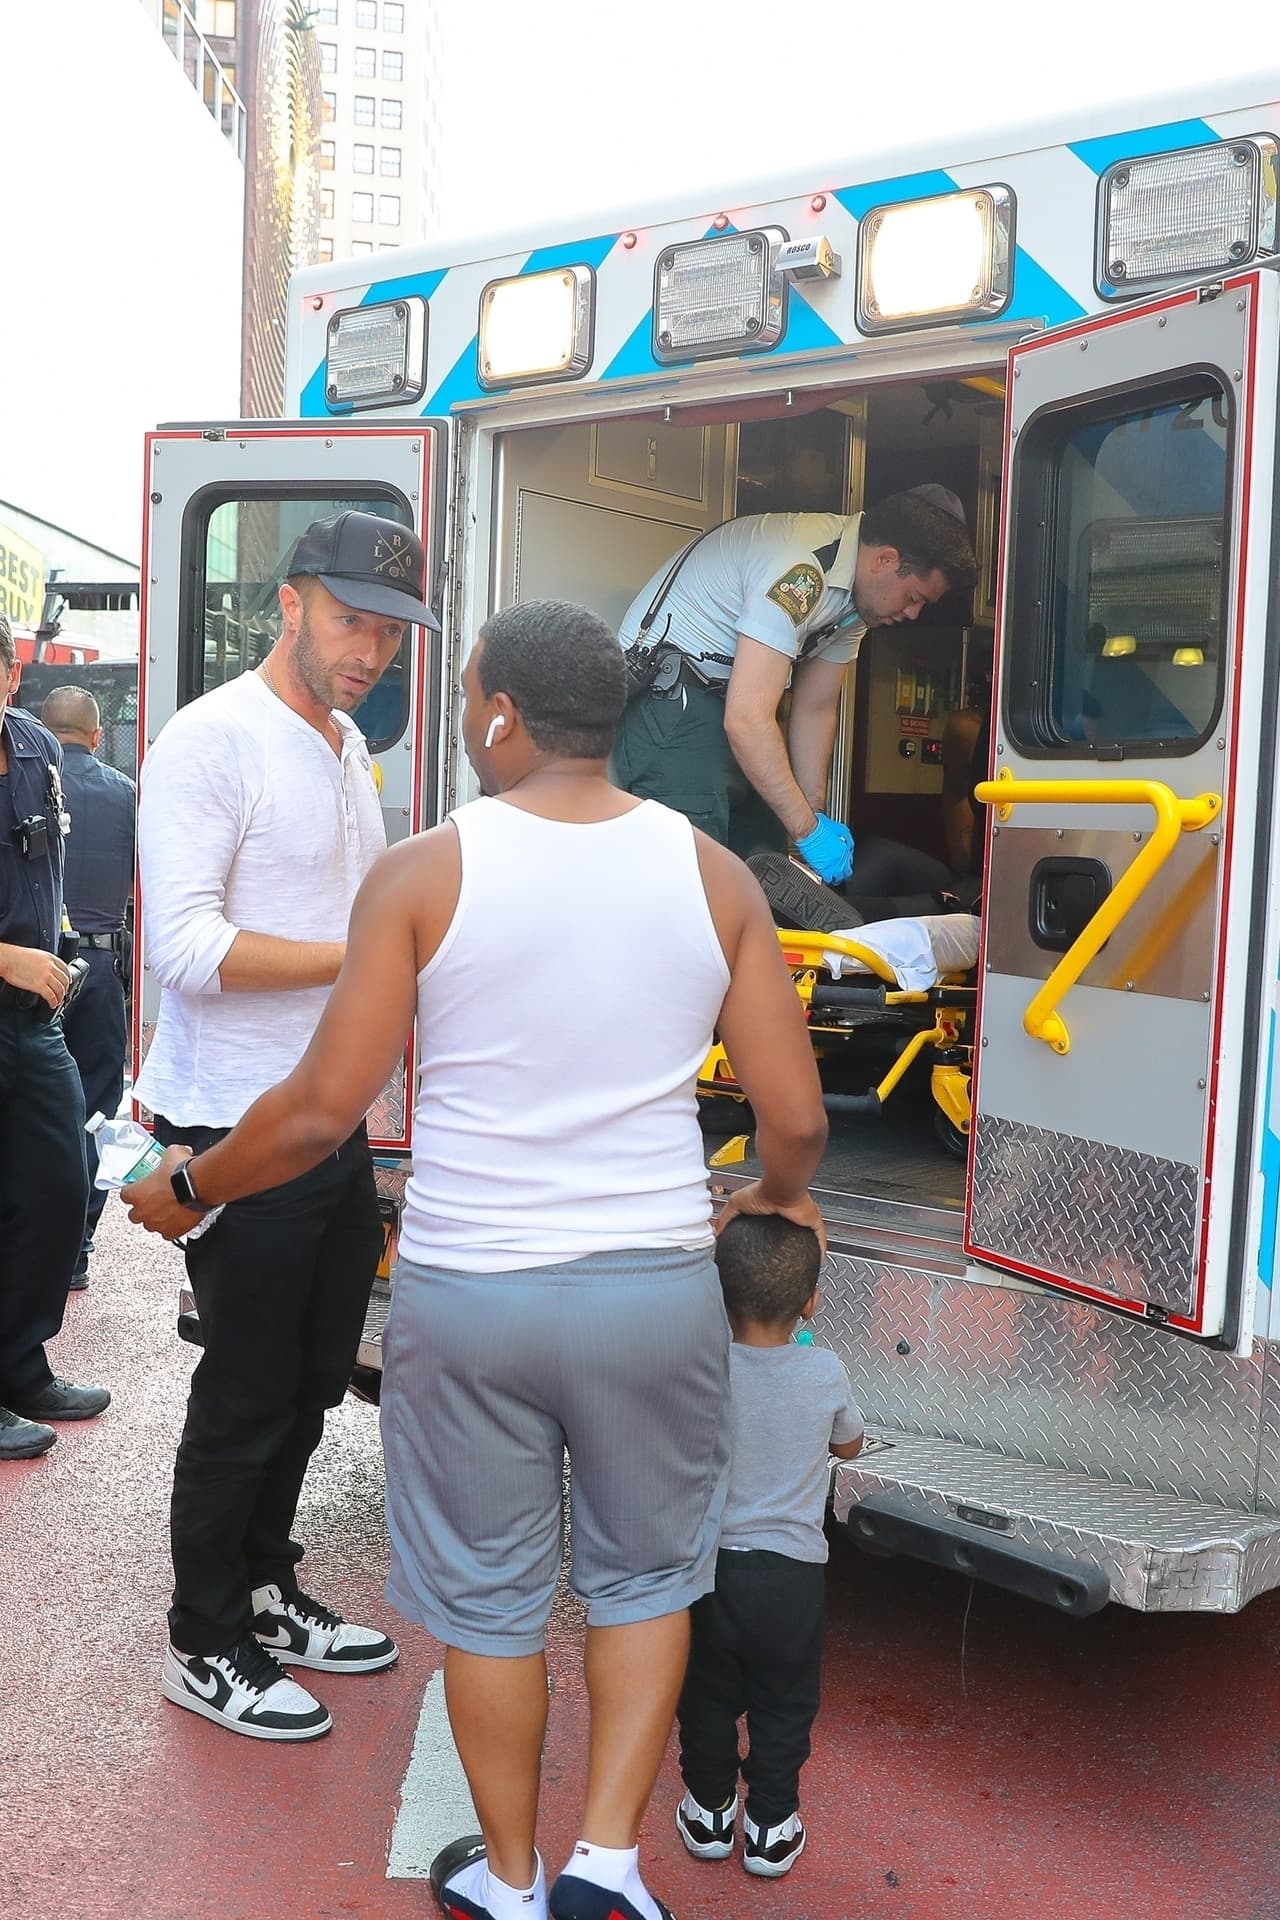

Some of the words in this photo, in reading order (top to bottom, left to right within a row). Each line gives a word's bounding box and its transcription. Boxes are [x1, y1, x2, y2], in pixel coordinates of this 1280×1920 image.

[786, 243, 811, 254] ROSCO
[0, 544, 39, 599] BEST
[0, 584, 34, 622] BUY
